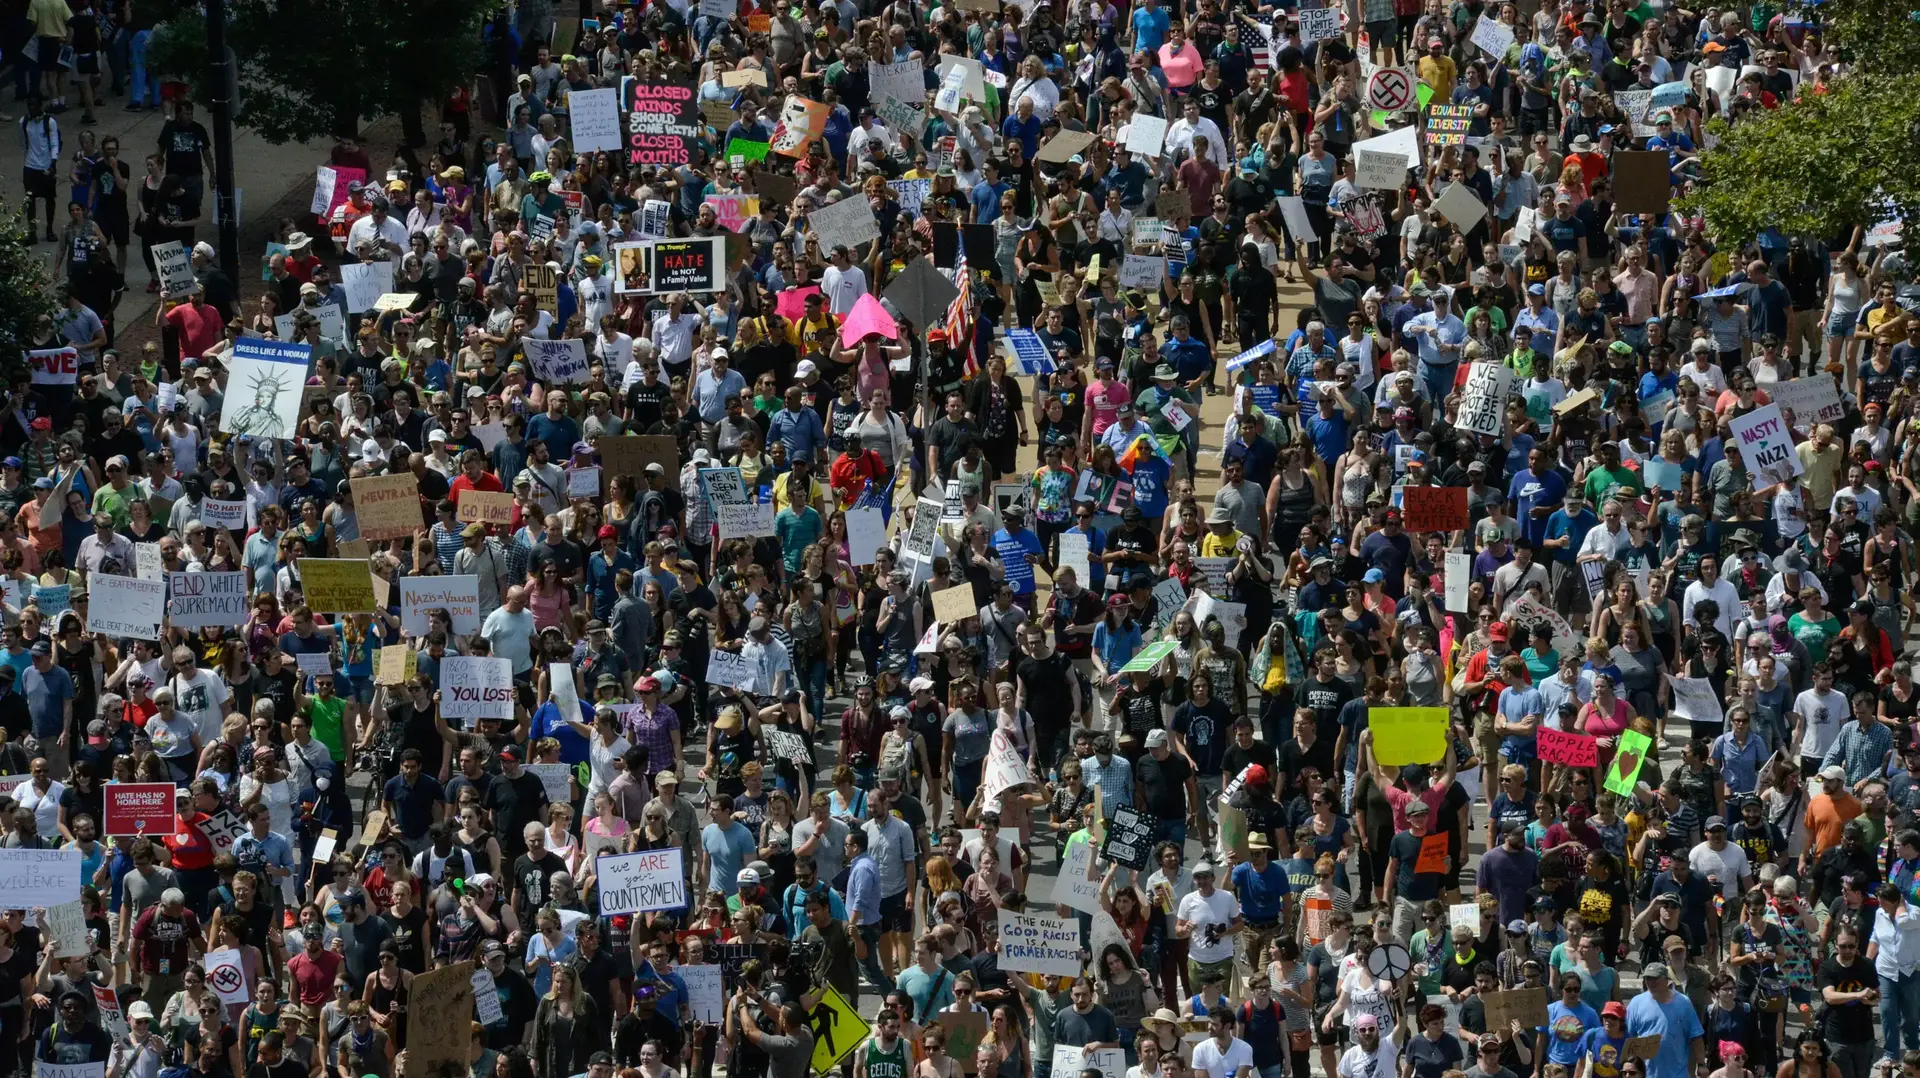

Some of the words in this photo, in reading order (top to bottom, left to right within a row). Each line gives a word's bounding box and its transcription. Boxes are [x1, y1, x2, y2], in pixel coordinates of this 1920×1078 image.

[1301, 9, 1329, 21] STOP
[1310, 18, 1333, 30] WHITE
[1310, 29, 1340, 40] PEOPLE
[635, 84, 691, 100] CLOSED
[633, 100, 681, 115] MINDS
[1430, 104, 1474, 117] EQUALITY
[629, 112, 676, 125] SHOULD
[1427, 118, 1472, 131] DIVERSITY
[629, 123, 662, 134] COME
[663, 123, 698, 138] WITH
[631, 135, 683, 150] CLOSED
[1425, 133, 1465, 145] TOGETHER
[631, 149, 689, 165] MOUTHS
[887, 180, 910, 193] FREE
[664, 253, 704, 269] HATE
[526, 265, 556, 289] END
[667, 276, 688, 285] Family
[689, 275, 708, 283] Value
[319, 310, 337, 319] ARE
[235, 343, 259, 355] DRESS
[259, 346, 276, 356] LIKE
[276, 347, 283, 357] A
[283, 349, 310, 360] WOMAN
[1476, 364, 1499, 380] WE
[1468, 379, 1499, 399] SHALL
[1460, 397, 1482, 411] NOT
[1482, 400, 1498, 414] BE
[1818, 403, 1841, 420] HERE
[1459, 412, 1497, 432] MOVED
[1740, 418, 1780, 445] NASTY
[1755, 444, 1790, 468] NAZI
[704, 472, 738, 482] WE'VE
[711, 482, 738, 491] SEEN
[710, 491, 733, 501] THIS
[1408, 491, 1456, 503] BLACK
[221, 504, 242, 512] HATE
[462, 504, 478, 518] GO
[1409, 503, 1455, 514] LIVES
[1408, 516, 1463, 530] MATTER
[94, 578, 107, 587] WE
[109, 580, 123, 589] BEAT
[134, 582, 161, 594] BEFORE
[172, 574, 206, 596] END
[209, 573, 245, 595] WHITE
[174, 596, 246, 617] SUPREMACY!
[451, 606, 476, 616] DUH.
[1537, 606, 1571, 640] NAZIS
[714, 651, 748, 668] LOVE
[450, 686, 480, 702] YOU
[445, 702, 471, 717] SUCK
[478, 702, 490, 715] IT
[768, 729, 786, 743] NOT
[1539, 730, 1597, 751] TOPPLE
[1538, 743, 1596, 764] RACISM
[114, 792, 135, 800] HATE
[152, 791, 166, 799] NO
[141, 798, 165, 806] HERE.
[1117, 813, 1136, 828] NOT
[1122, 831, 1137, 843] MY
[1135, 824, 1149, 835] ON
[1, 851, 26, 861] WHITE
[35, 851, 72, 862] SILENCE
[1110, 843, 1135, 857] WATCH
[26, 864, 39, 875] IS
[610, 861, 631, 874] we
[638, 854, 670, 872] ARE
[0, 875, 66, 890] VIOLENCE
[623, 872, 655, 889] your
[602, 881, 683, 912] COUNTRYMEN
[1014, 915, 1036, 927] THE
[1040, 919, 1064, 930] ONLY
[1003, 924, 1039, 938] GOOD
[1042, 928, 1078, 941] RACIST
[1026, 938, 1037, 946] IS
[1040, 939, 1048, 947] A
[710, 943, 757, 959] STILL
[1005, 944, 1046, 959] FORMER
[1045, 946, 1081, 961] RACIST
[1057, 1049, 1077, 1065] THE
[1086, 1052, 1117, 1068] ALT
[870, 1061, 902, 1078] CELTICS
